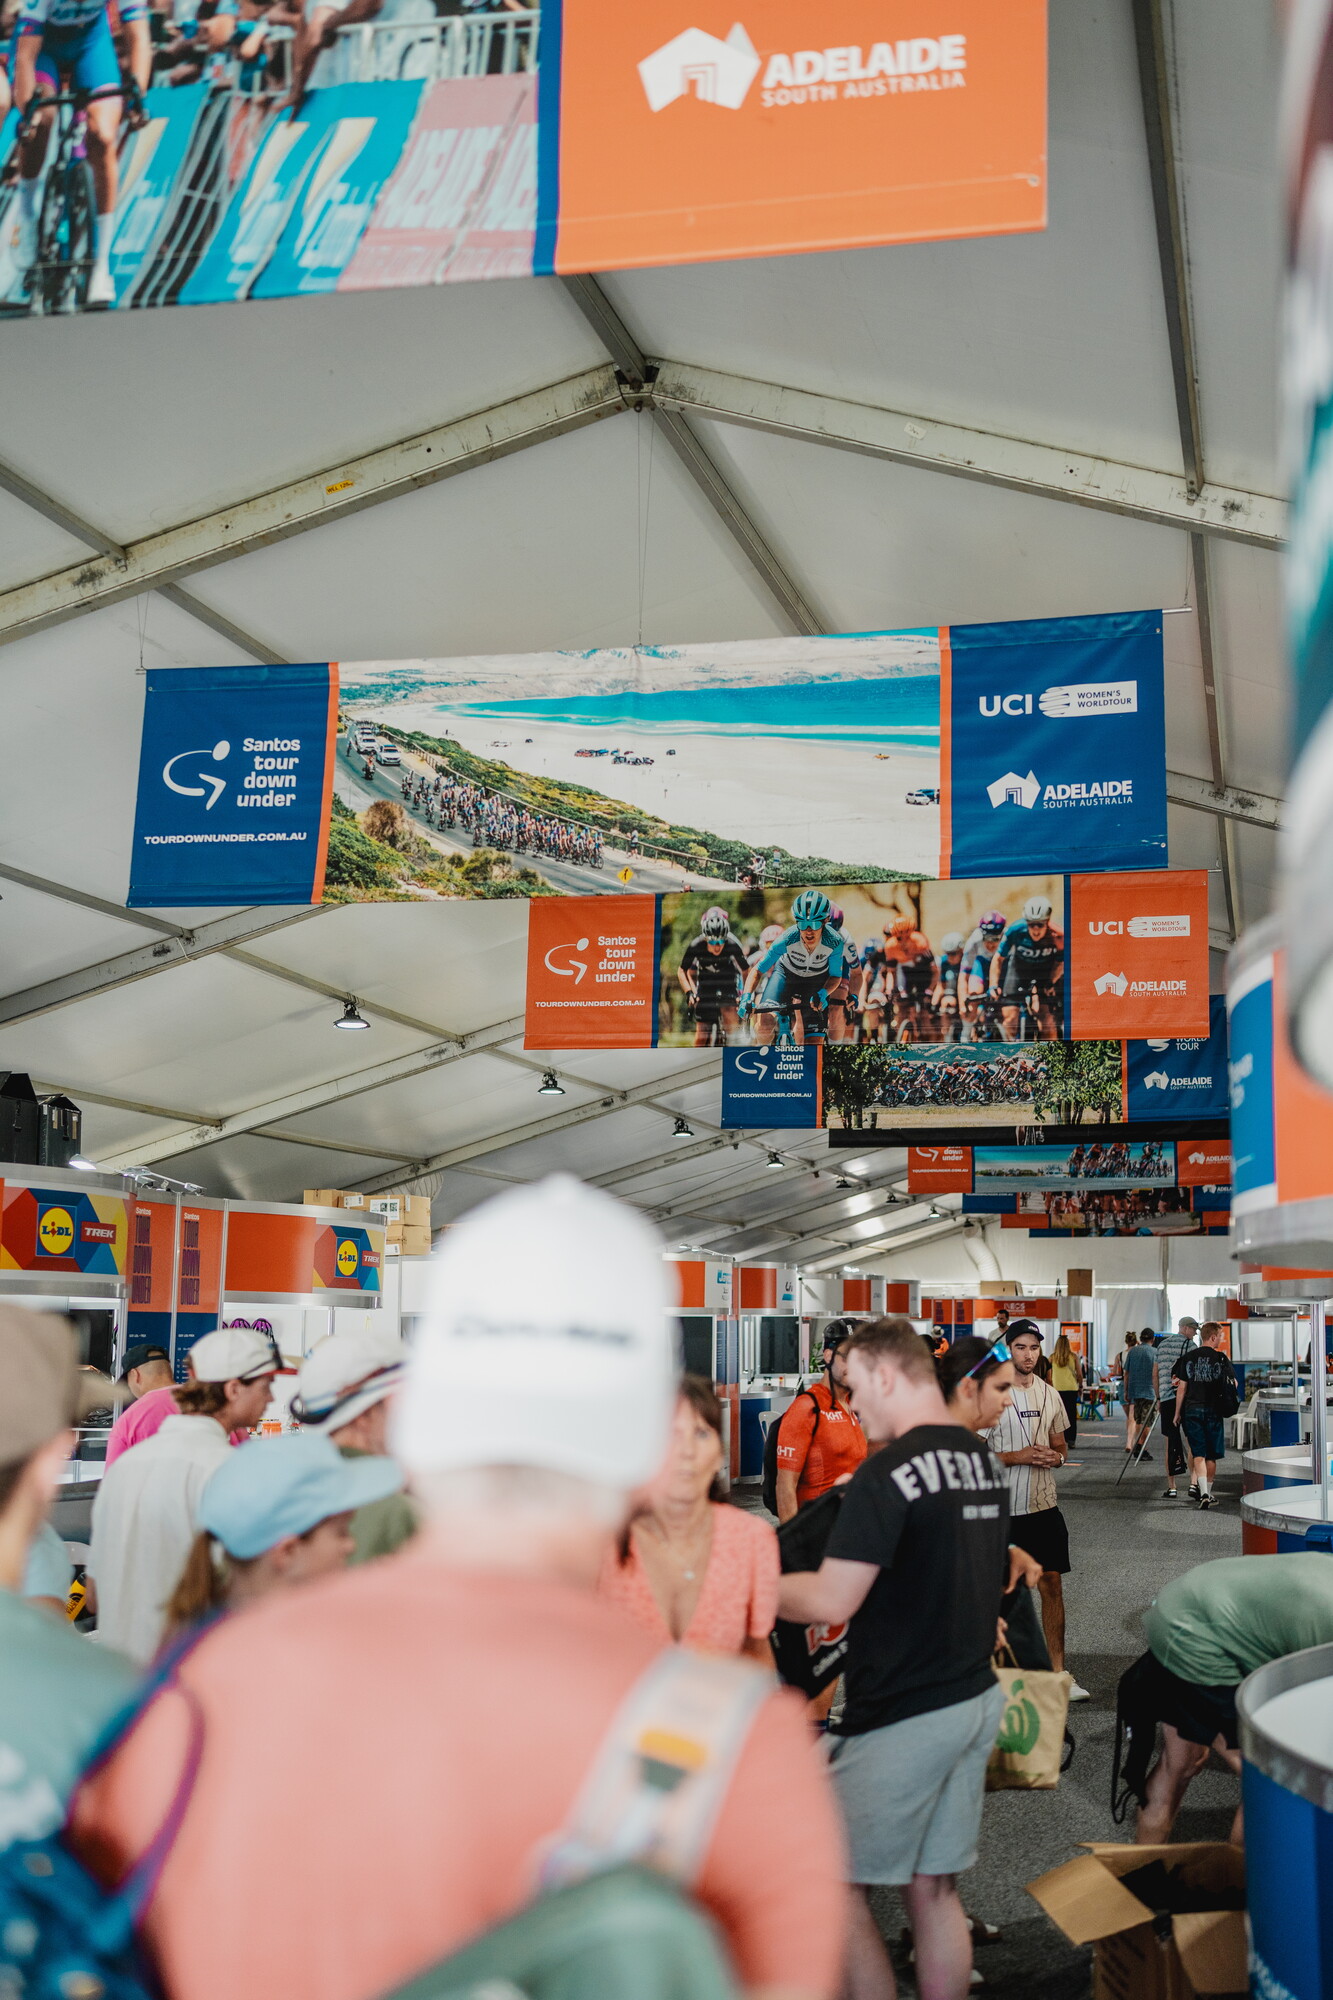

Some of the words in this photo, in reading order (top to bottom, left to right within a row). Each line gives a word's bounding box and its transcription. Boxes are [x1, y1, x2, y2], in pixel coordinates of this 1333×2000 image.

[761, 34, 966, 89] ADELAIDE
[761, 85, 837, 107] SOUTH
[844, 71, 966, 99] AUSTRALIA
[1077, 690, 1121, 699] WOMEN'S
[979, 694, 1033, 717] UCI
[1078, 697, 1132, 708] WORLDTOUR
[242, 737, 301, 752] Santos
[254, 755, 299, 770] tour
[244, 772, 296, 789] down
[1043, 780, 1133, 801] ADELAIDE
[236, 790, 296, 807] under
[1043, 800, 1076, 809] SOUTH
[1079, 796, 1133, 807] AUSTRALIA
[144, 832, 307, 845] TOURDOWNUNDER.COM.AU
[1089, 920, 1123, 936] UCI
[597, 936, 637, 946] Santos
[606, 948, 636, 958] tour
[598, 959, 635, 970] down
[595, 972, 635, 983] under
[1130, 980, 1187, 991] ADELAIDE
[535, 1000, 645, 1008] TOURDOWNUNDER.COM.AU
[1176, 1042, 1200, 1051] TOUR
[781, 1053, 804, 1061] tour
[776, 1062, 803, 1070] down
[773, 1071, 804, 1080] under
[1170, 1077, 1212, 1086] ADELAIDE
[84, 1227, 114, 1239] TREK
[363, 1255, 380, 1264] TREK
